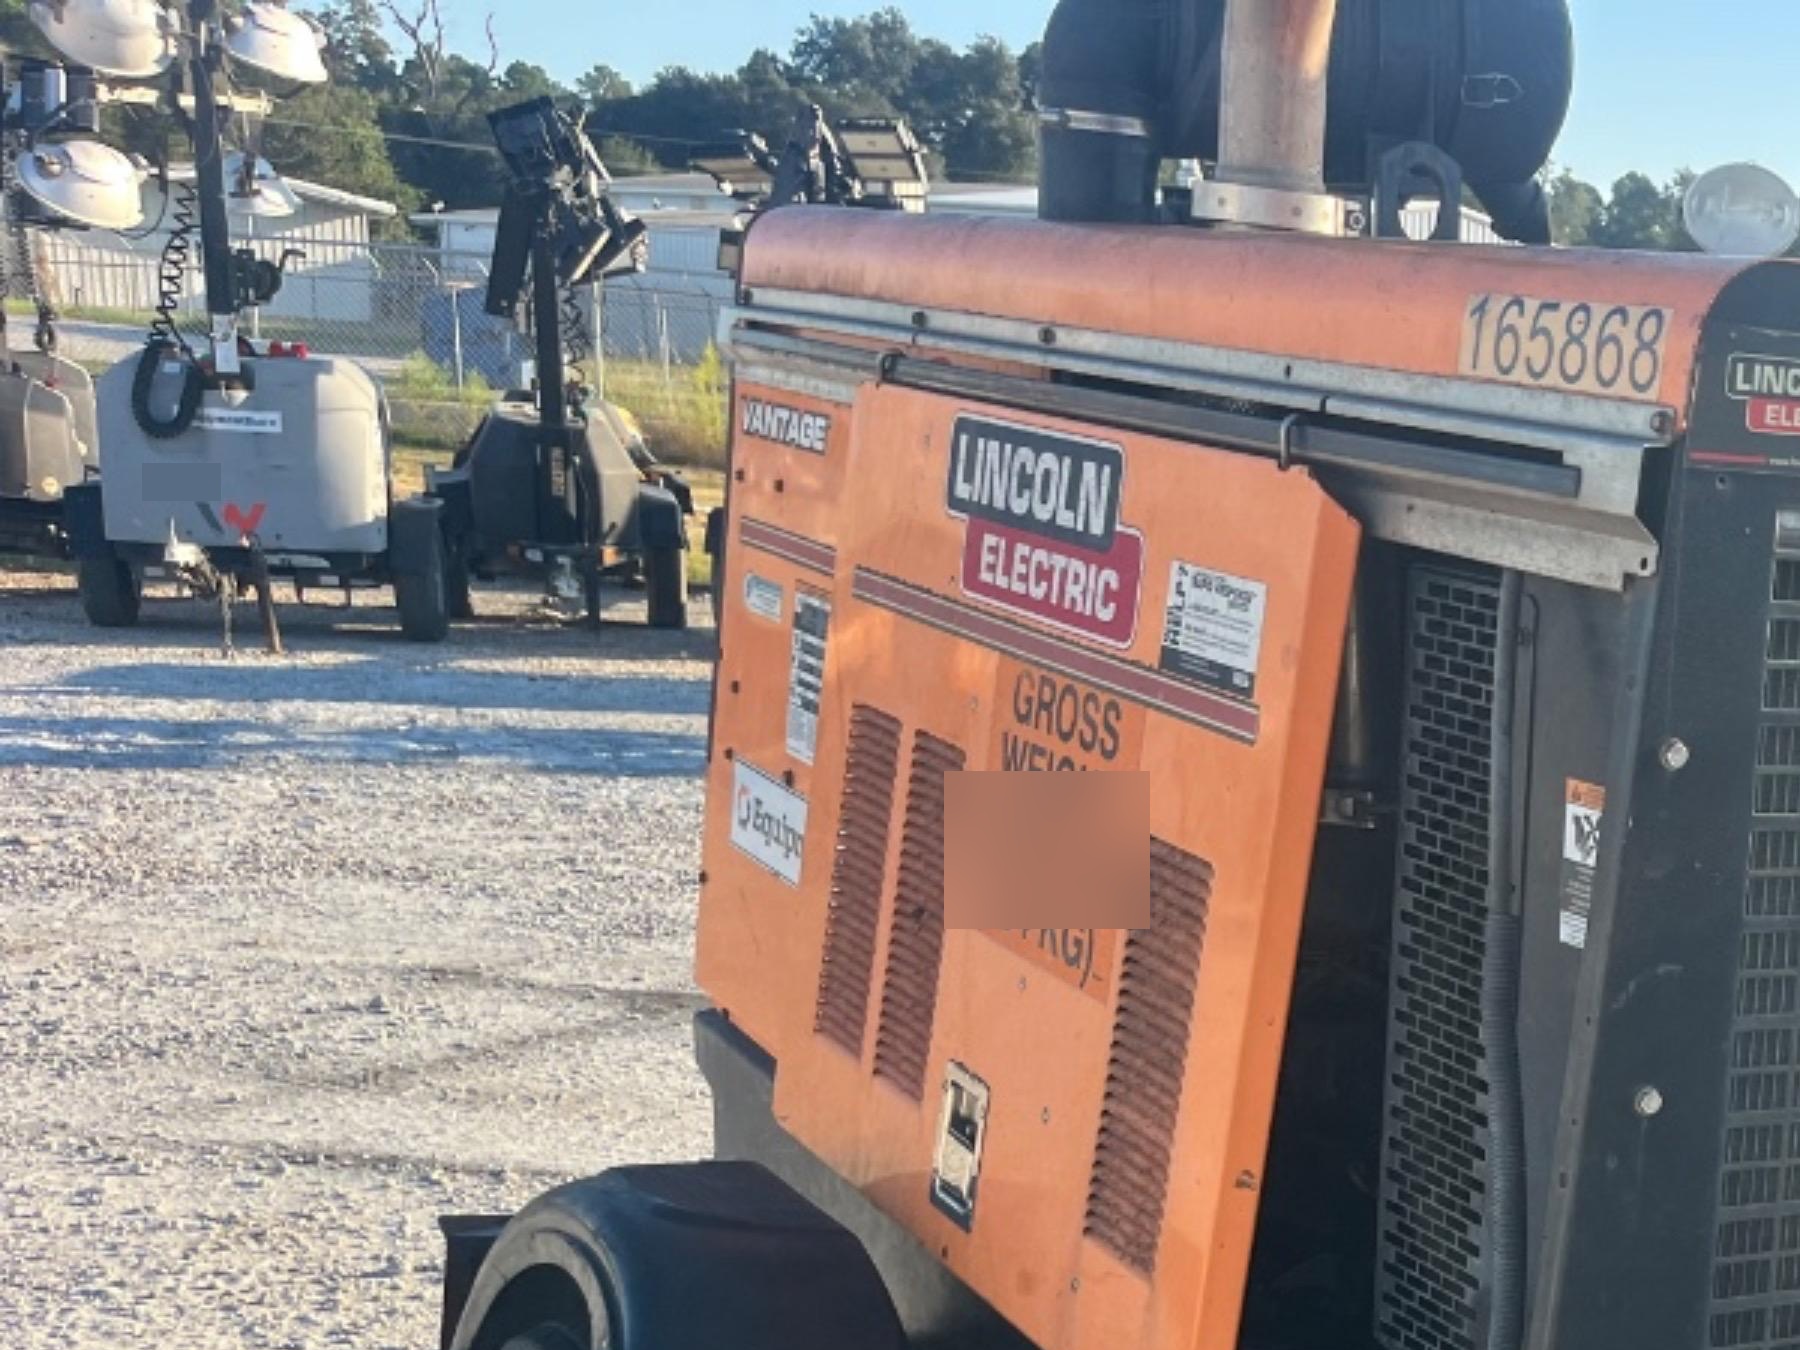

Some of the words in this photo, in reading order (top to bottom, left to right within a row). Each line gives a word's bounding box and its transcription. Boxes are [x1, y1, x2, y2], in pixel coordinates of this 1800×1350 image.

[1469, 294, 1664, 393] 165868
[742, 401, 829, 455] VANTAGE
[953, 431, 1112, 536] LINCOLN
[977, 532, 1121, 623] ELECTRIC
[1012, 670, 1123, 761] GROSS
